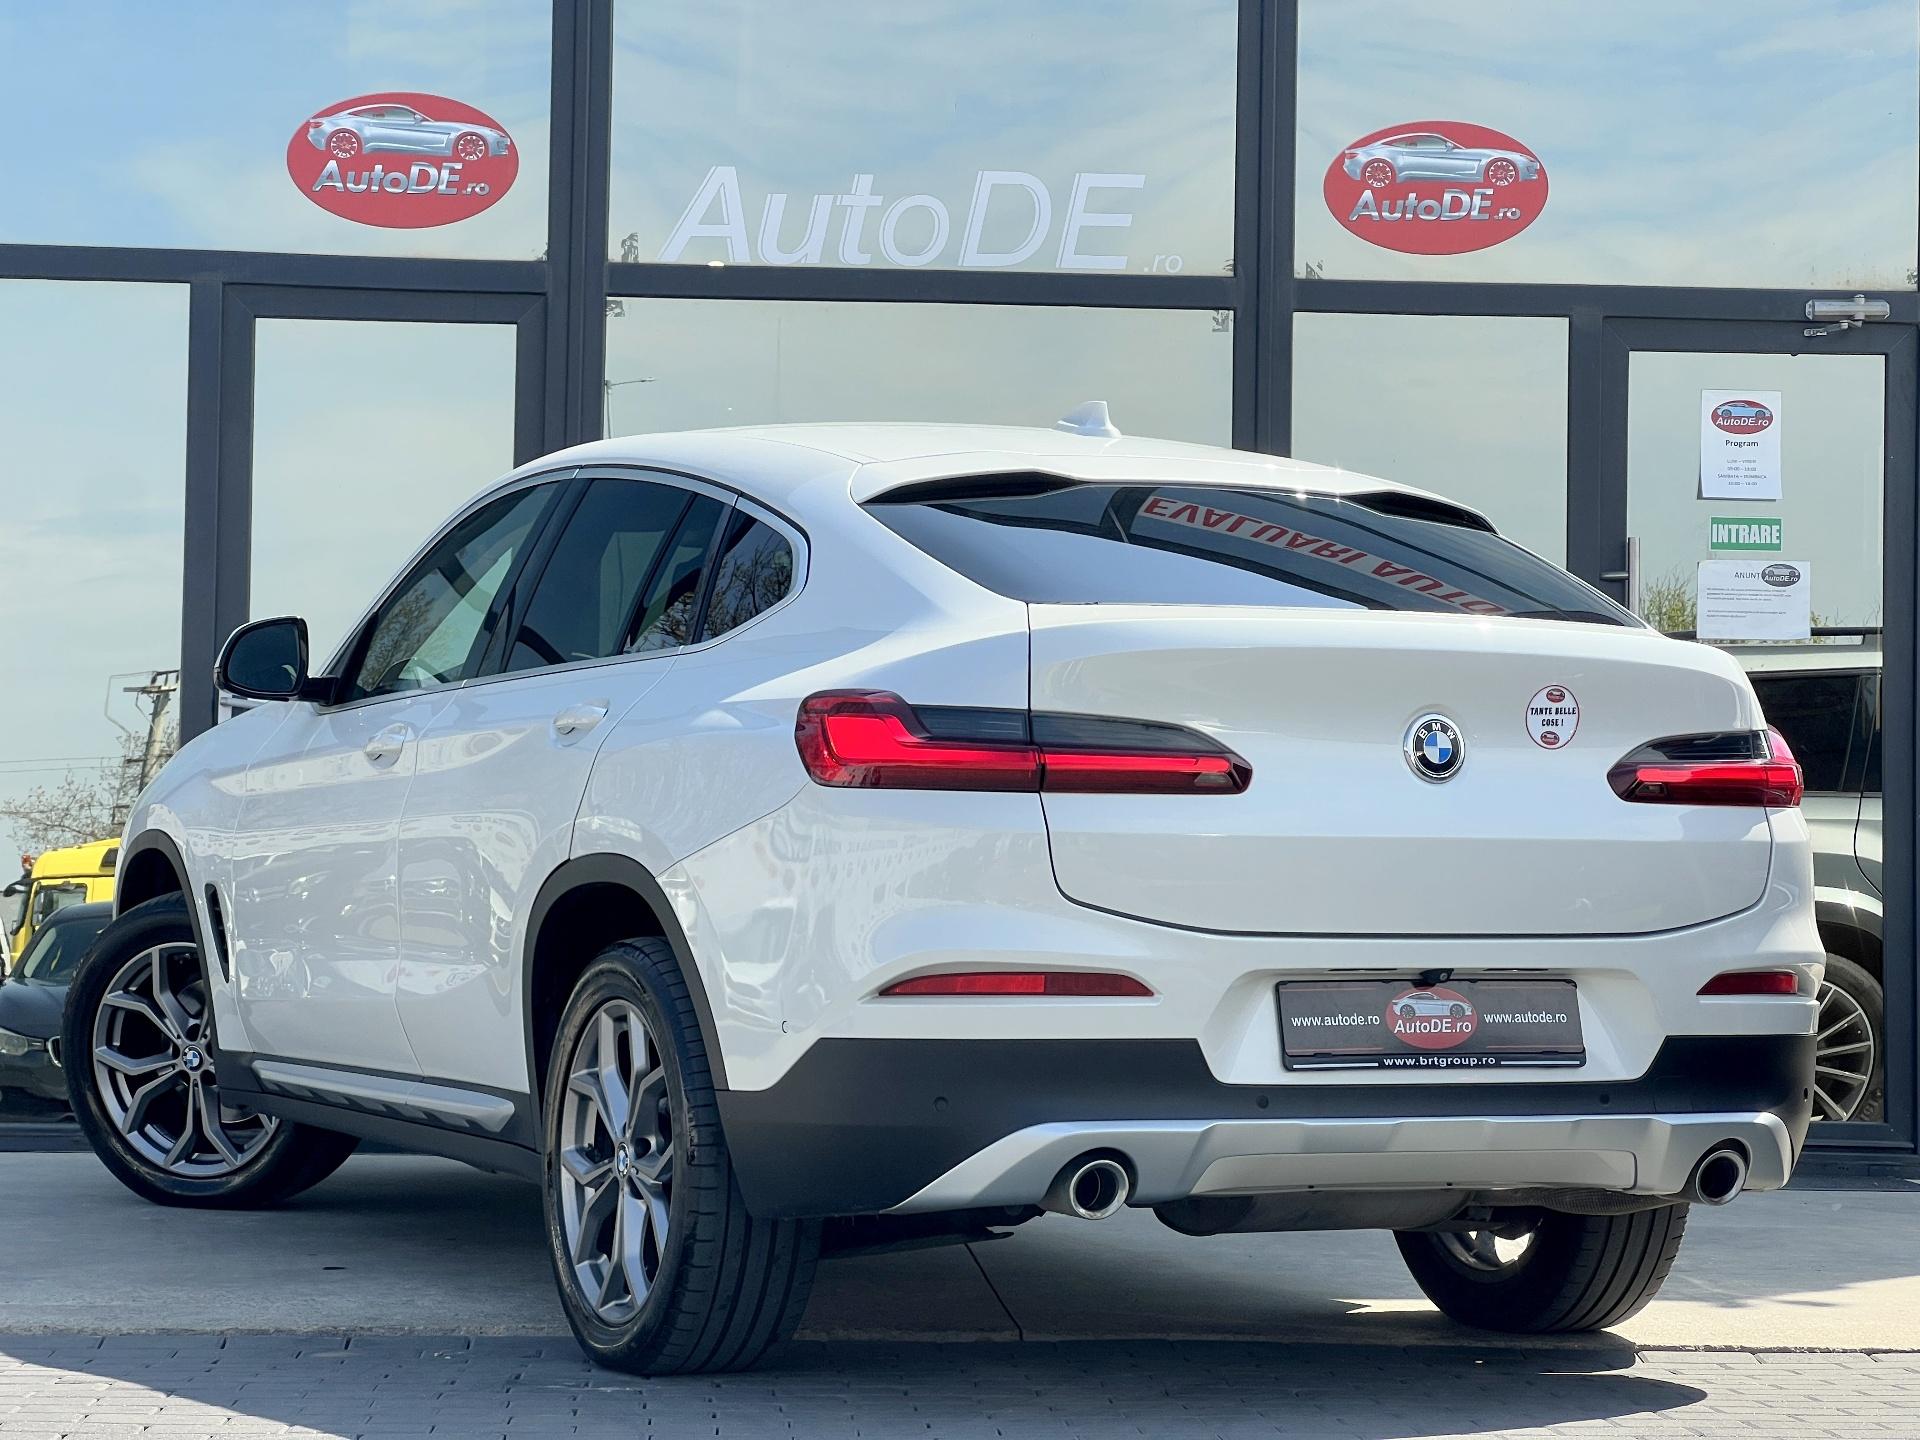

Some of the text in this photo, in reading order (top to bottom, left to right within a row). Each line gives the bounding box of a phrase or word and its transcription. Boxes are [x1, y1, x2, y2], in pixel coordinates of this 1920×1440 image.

[1715, 417, 1769, 427] AutoDE.ro
[1725, 440, 1759, 448] Program
[1712, 523, 1780, 544] INTRARE
[1530, 707, 1577, 716] TANTE BELLE
[1541, 718, 1559, 727] COSE
[1419, 722, 1455, 739] BMW
[1291, 1013, 1380, 1027] www.autode.ro
[1484, 1011, 1567, 1024] www.autode.ro
[1393, 1018, 1472, 1034] AutoDE.ro
[1383, 1056, 1496, 1067] www.brtgroup.ro
